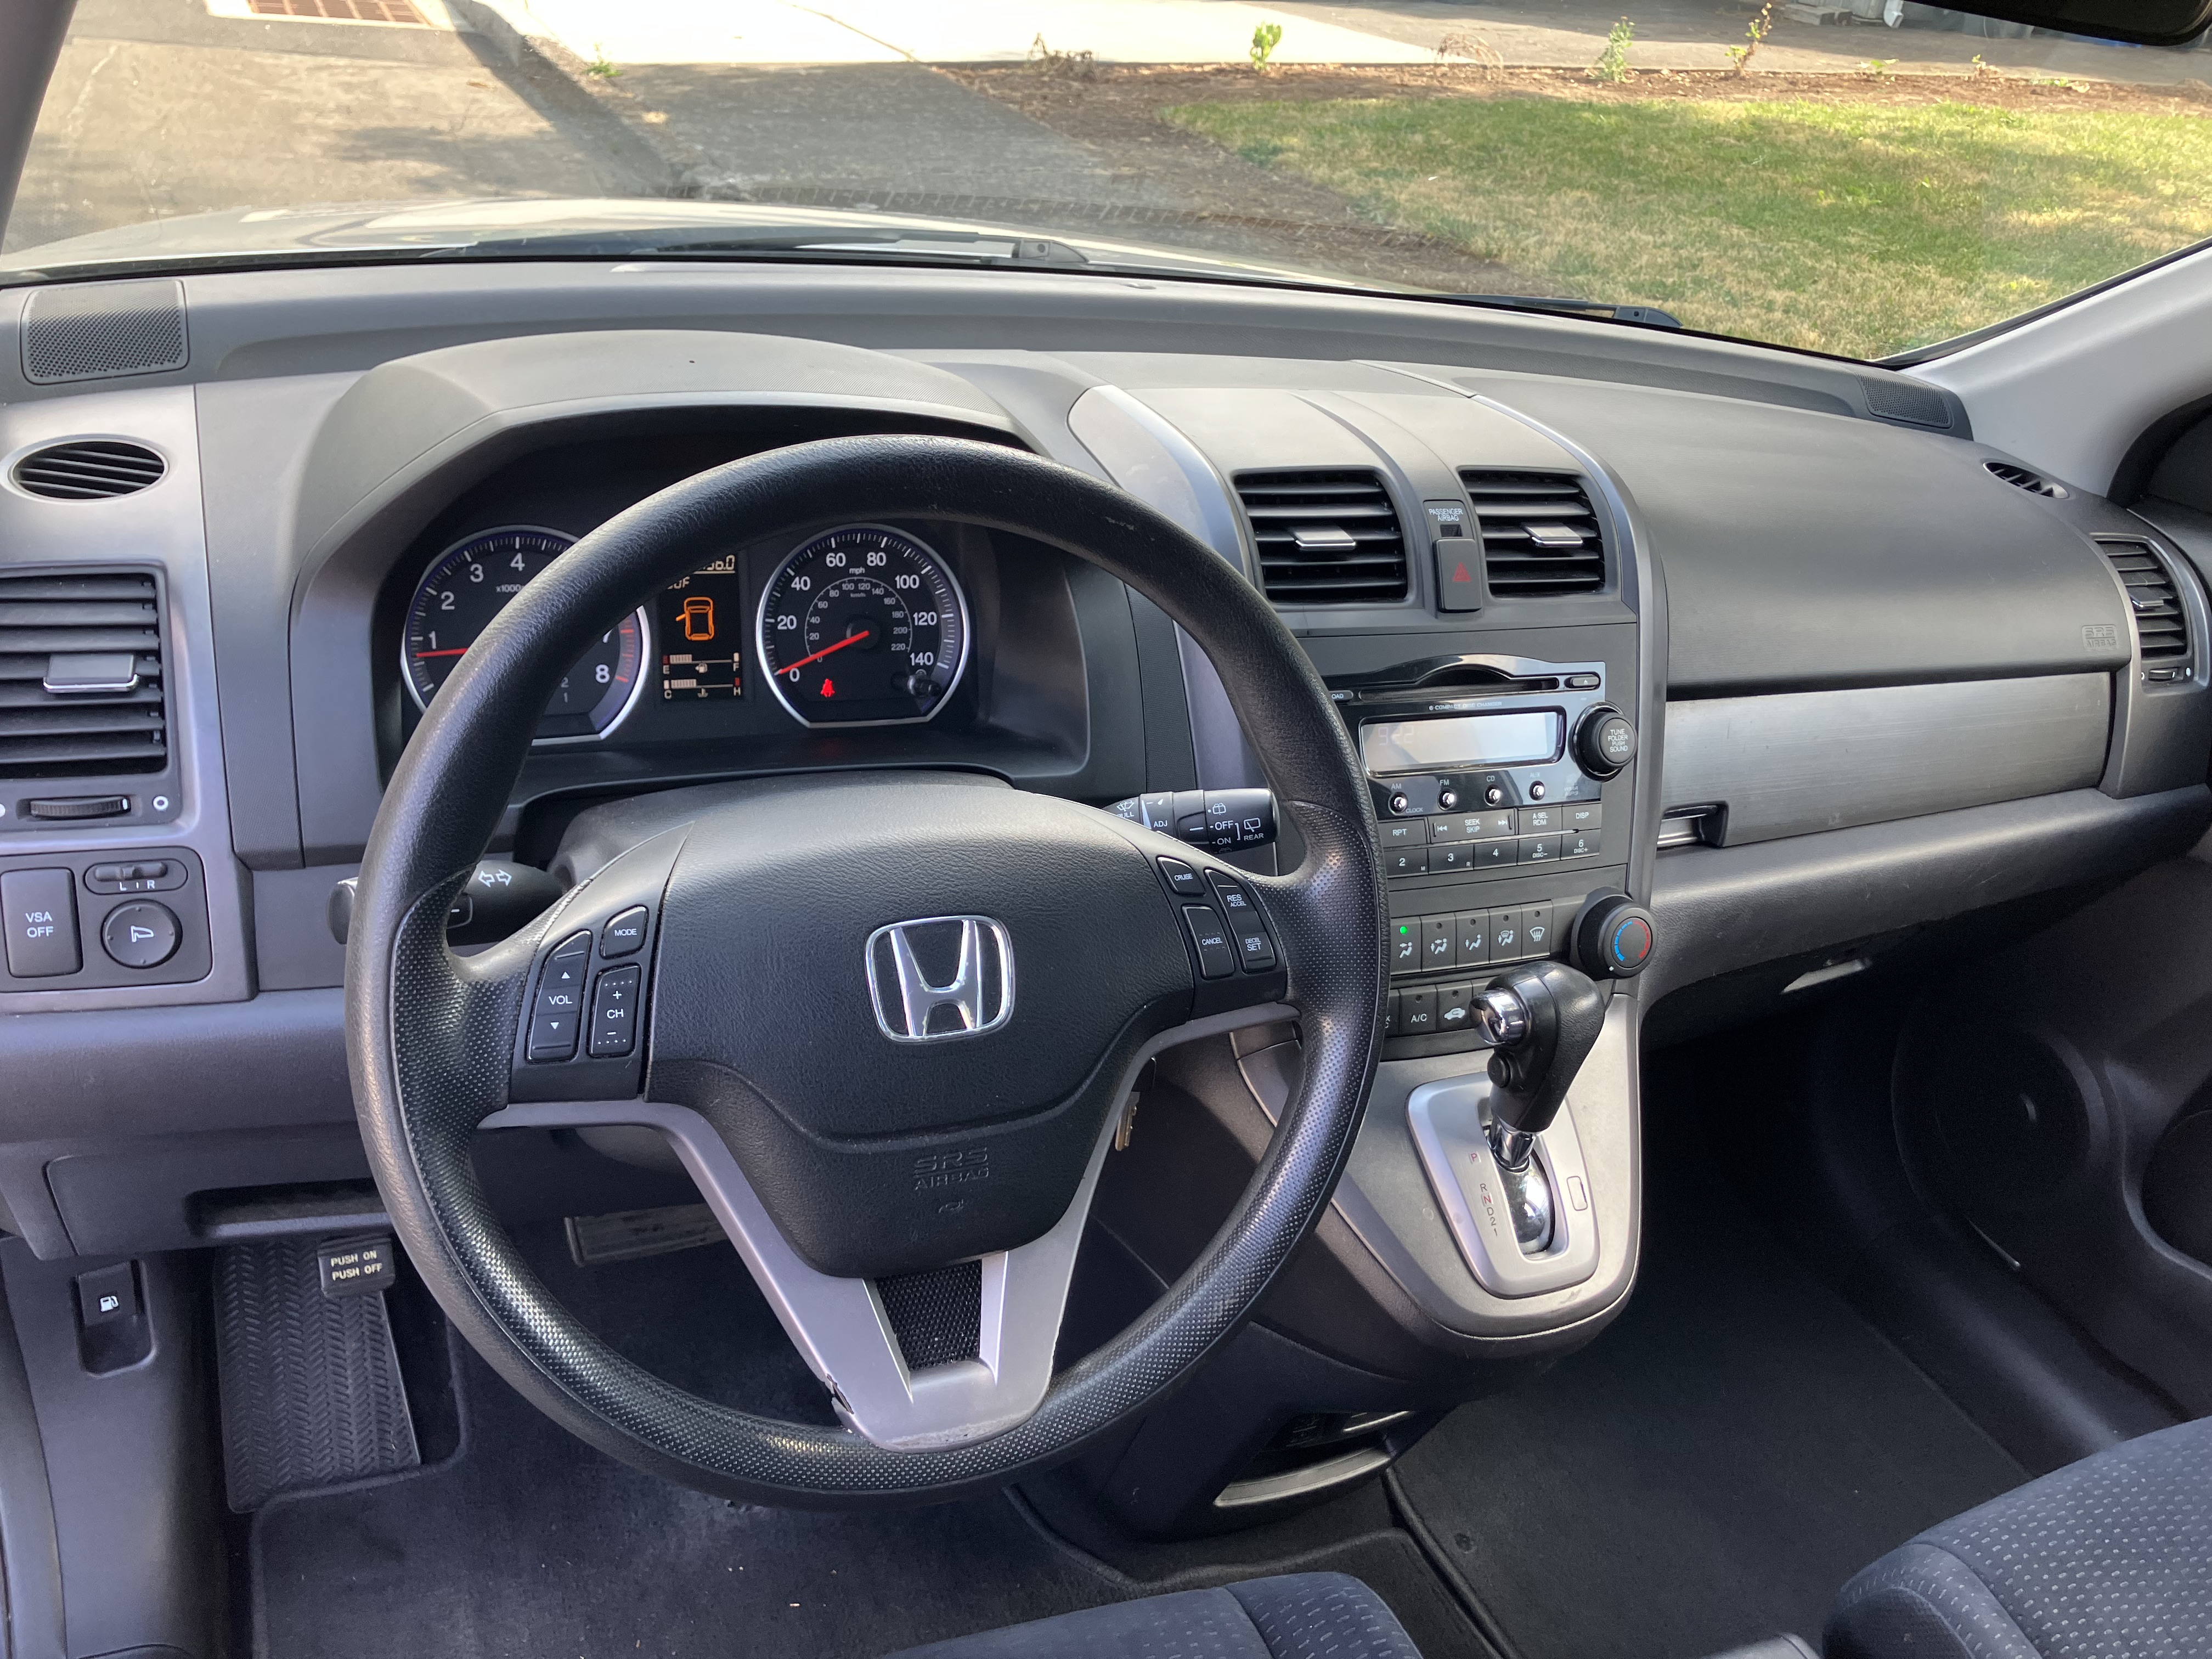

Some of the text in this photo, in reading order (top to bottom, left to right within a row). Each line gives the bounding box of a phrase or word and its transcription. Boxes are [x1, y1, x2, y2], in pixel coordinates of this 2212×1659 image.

[511, 553, 524, 571] 4
[826, 552, 846, 567] 60
[867, 552, 887, 566] 80
[470, 564, 484, 582] 3
[849, 567, 865, 575] mph
[791, 576, 811, 591] 40
[895, 574, 919, 589] 100
[441, 591, 455, 610] 2
[777, 615, 797, 629] 20
[810, 616, 820, 624] 40
[913, 612, 937, 625] 120
[429, 631, 437, 649] 1
[809, 632, 820, 640] 20
[910, 652, 934, 666] 140
[595, 664, 610, 683] 8
[789, 667, 800, 682] 0
[733, 687, 741, 696] H
[1215, 820, 1234, 831] OFF
[1244, 833, 1264, 841] REAR
[1537, 843, 1543, 852] 5
[1578, 839, 1584, 848] 6
[1447, 853, 1454, 862] 3
[1492, 848, 1499, 856] 4
[1399, 857, 1406, 866] 2
[119, 879, 156, 890] L R
[1227, 894, 1242, 902] RES
[25, 911, 53, 923] VSA
[27, 926, 54, 938] OFF
[549, 995, 573, 1005] VOL
[607, 1008, 624, 1019] CH
[1410, 1013, 1427, 1023] A/C
[1470, 1153, 1477, 1161] P
[1480, 1183, 1487, 1192] R
[1483, 1194, 1492, 1205] N
[1487, 1207, 1494, 1216] D
[1490, 1216, 1497, 1226] 2
[330, 1250, 377, 1267] PUSH ON
[332, 1263, 382, 1282] PUSH OFF
